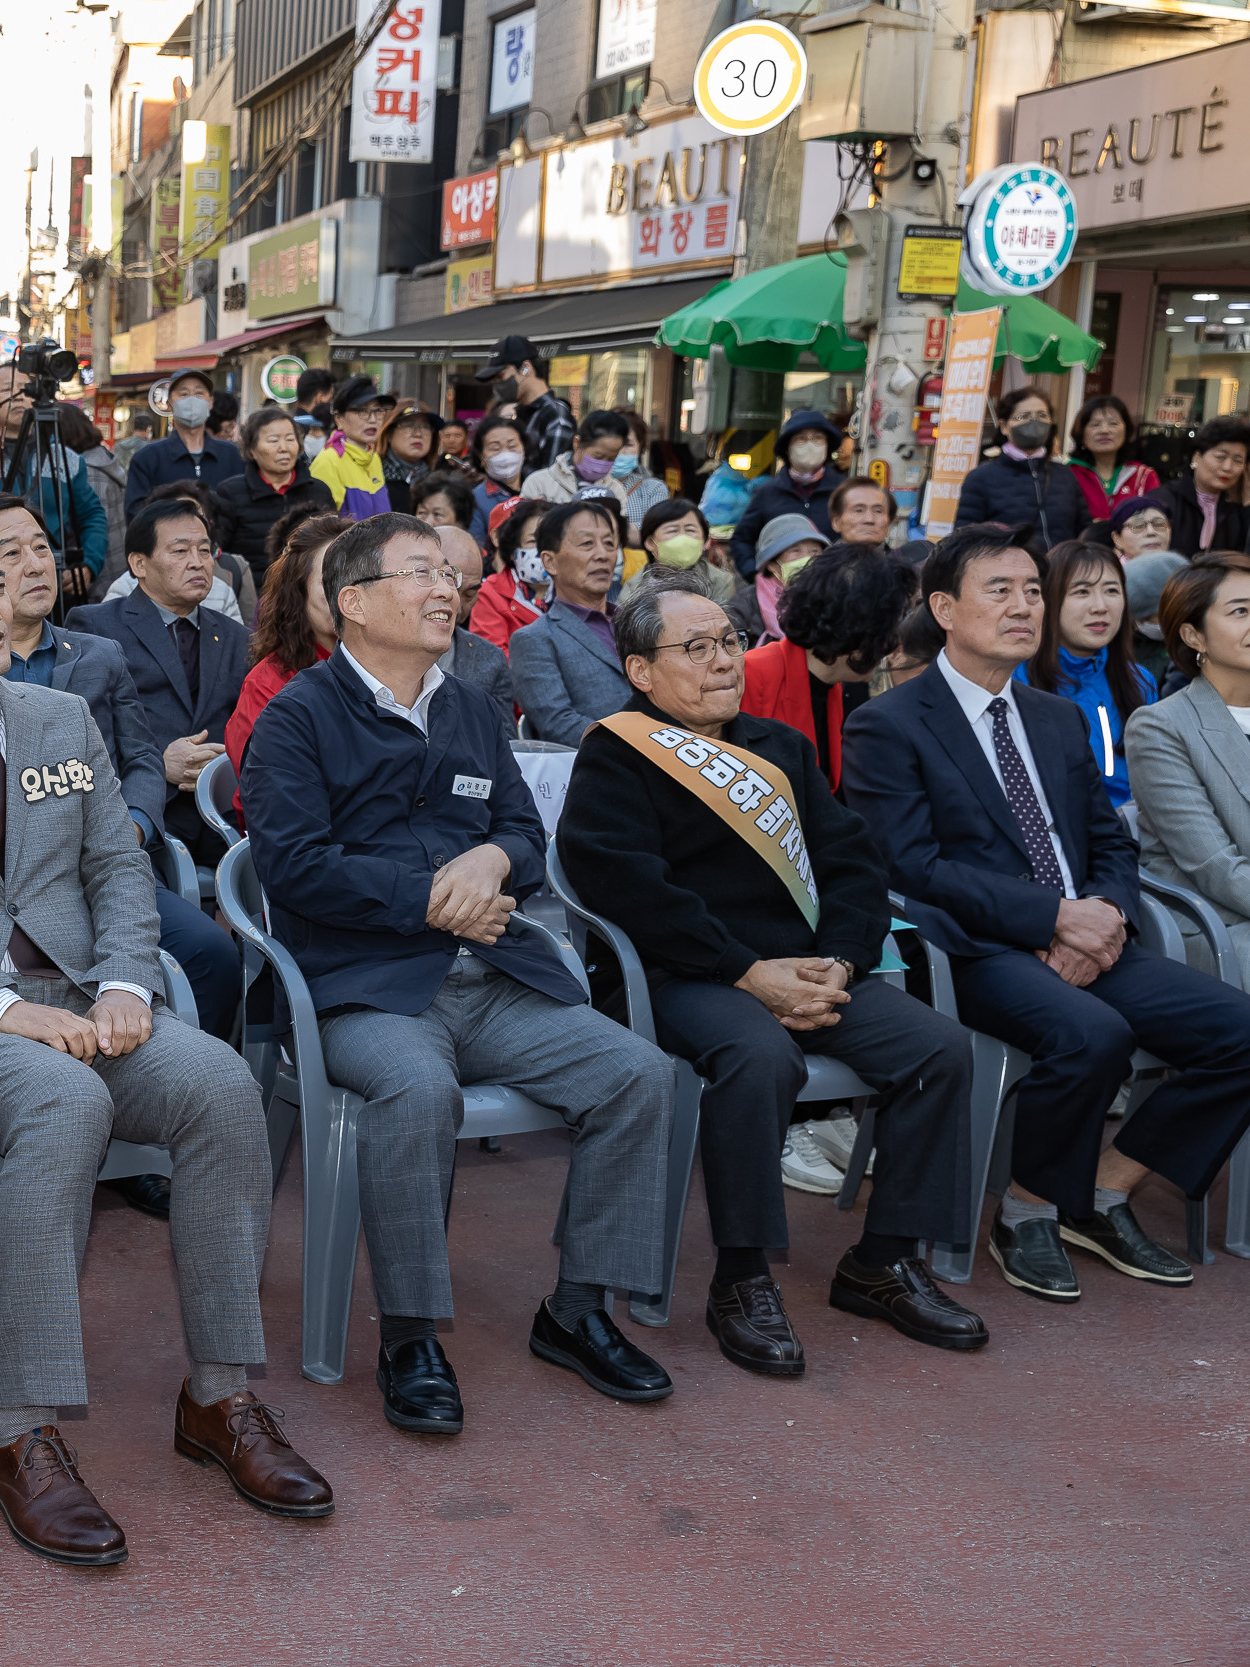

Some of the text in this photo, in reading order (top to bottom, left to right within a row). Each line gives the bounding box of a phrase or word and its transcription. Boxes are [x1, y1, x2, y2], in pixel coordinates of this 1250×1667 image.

[721, 59, 777, 98] 30
[1040, 84, 1230, 178] BEAUTÉ
[639, 204, 729, 257] 화장품
[21, 758, 95, 802] 오신환
